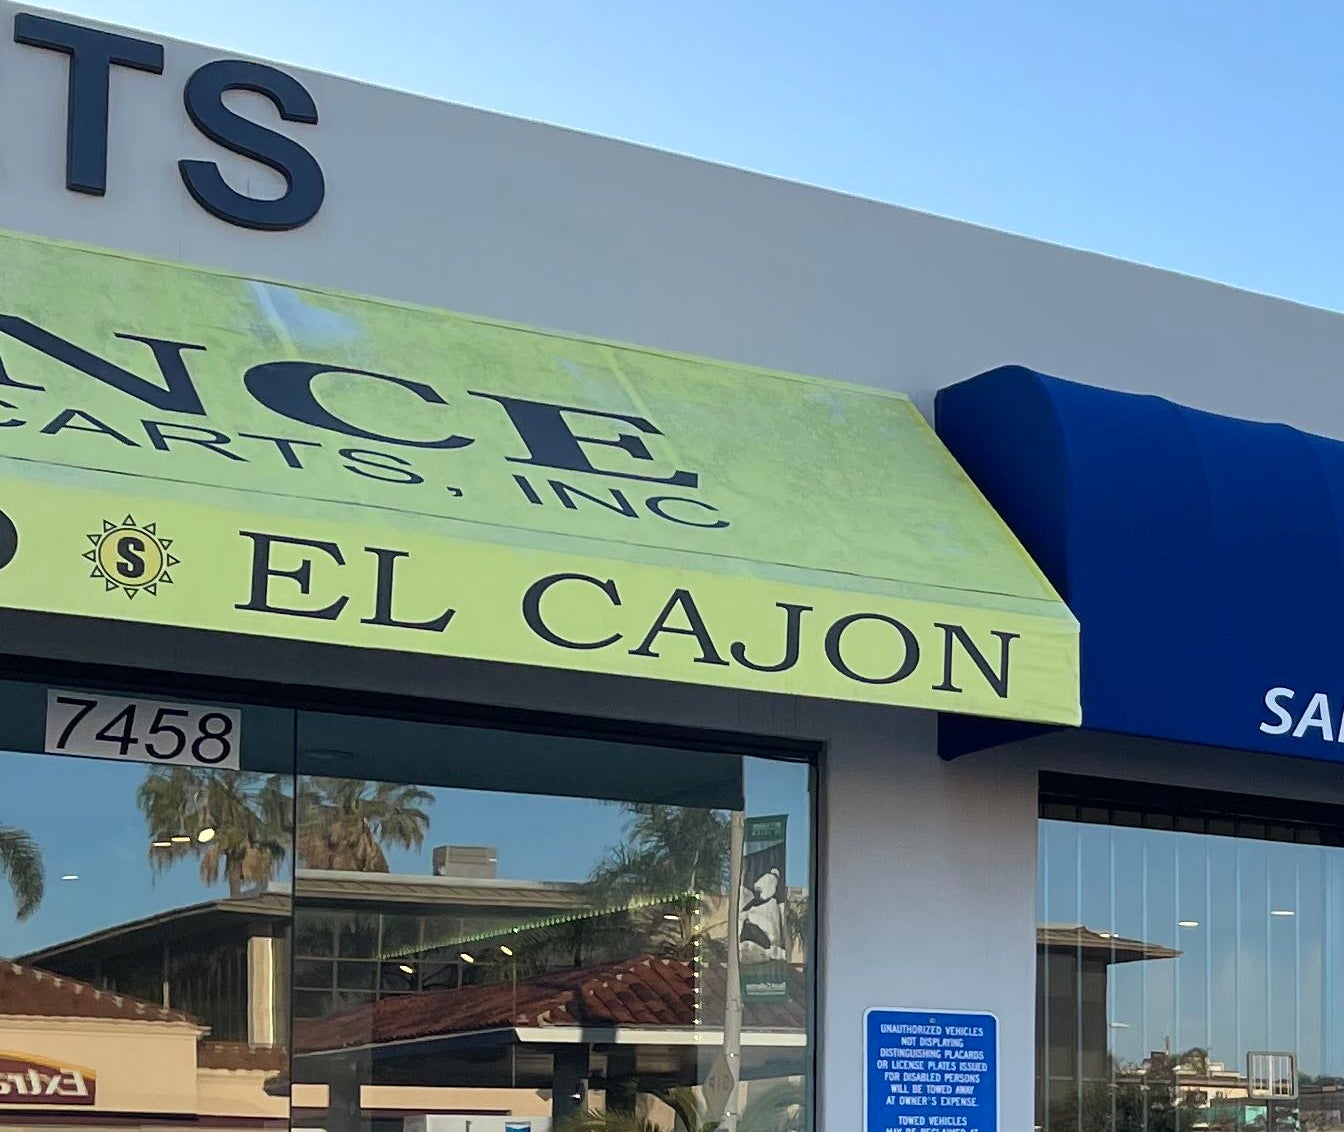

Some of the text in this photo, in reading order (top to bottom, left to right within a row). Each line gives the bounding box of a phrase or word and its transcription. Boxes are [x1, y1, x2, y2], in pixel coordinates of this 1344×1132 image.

[13, 13, 326, 232] TS
[511, 474, 730, 529] INC
[116, 537, 145, 578] S
[235, 530, 1020, 699] EL CAJON
[53, 697, 233, 765] 7458
[880, 1024, 984, 1037] UNAUTHORIZED VEHICLES
[901, 1037, 964, 1048] NOT DISPLAYING
[880, 1048, 985, 1060] DISTINGUISHING PLACARDS
[877, 1060, 988, 1072] OR LICENSE PLATES ISSUED
[884, 1072, 981, 1083] FOR DISABLED PERSONS
[891, 1084, 975, 1095] WILL BE TOWED AWAY
[886, 1096, 895, 1105] AT
[900, 1096, 937, 1106] OWNER'S
[898, 1116, 968, 1126] TOWED VEHICLES
